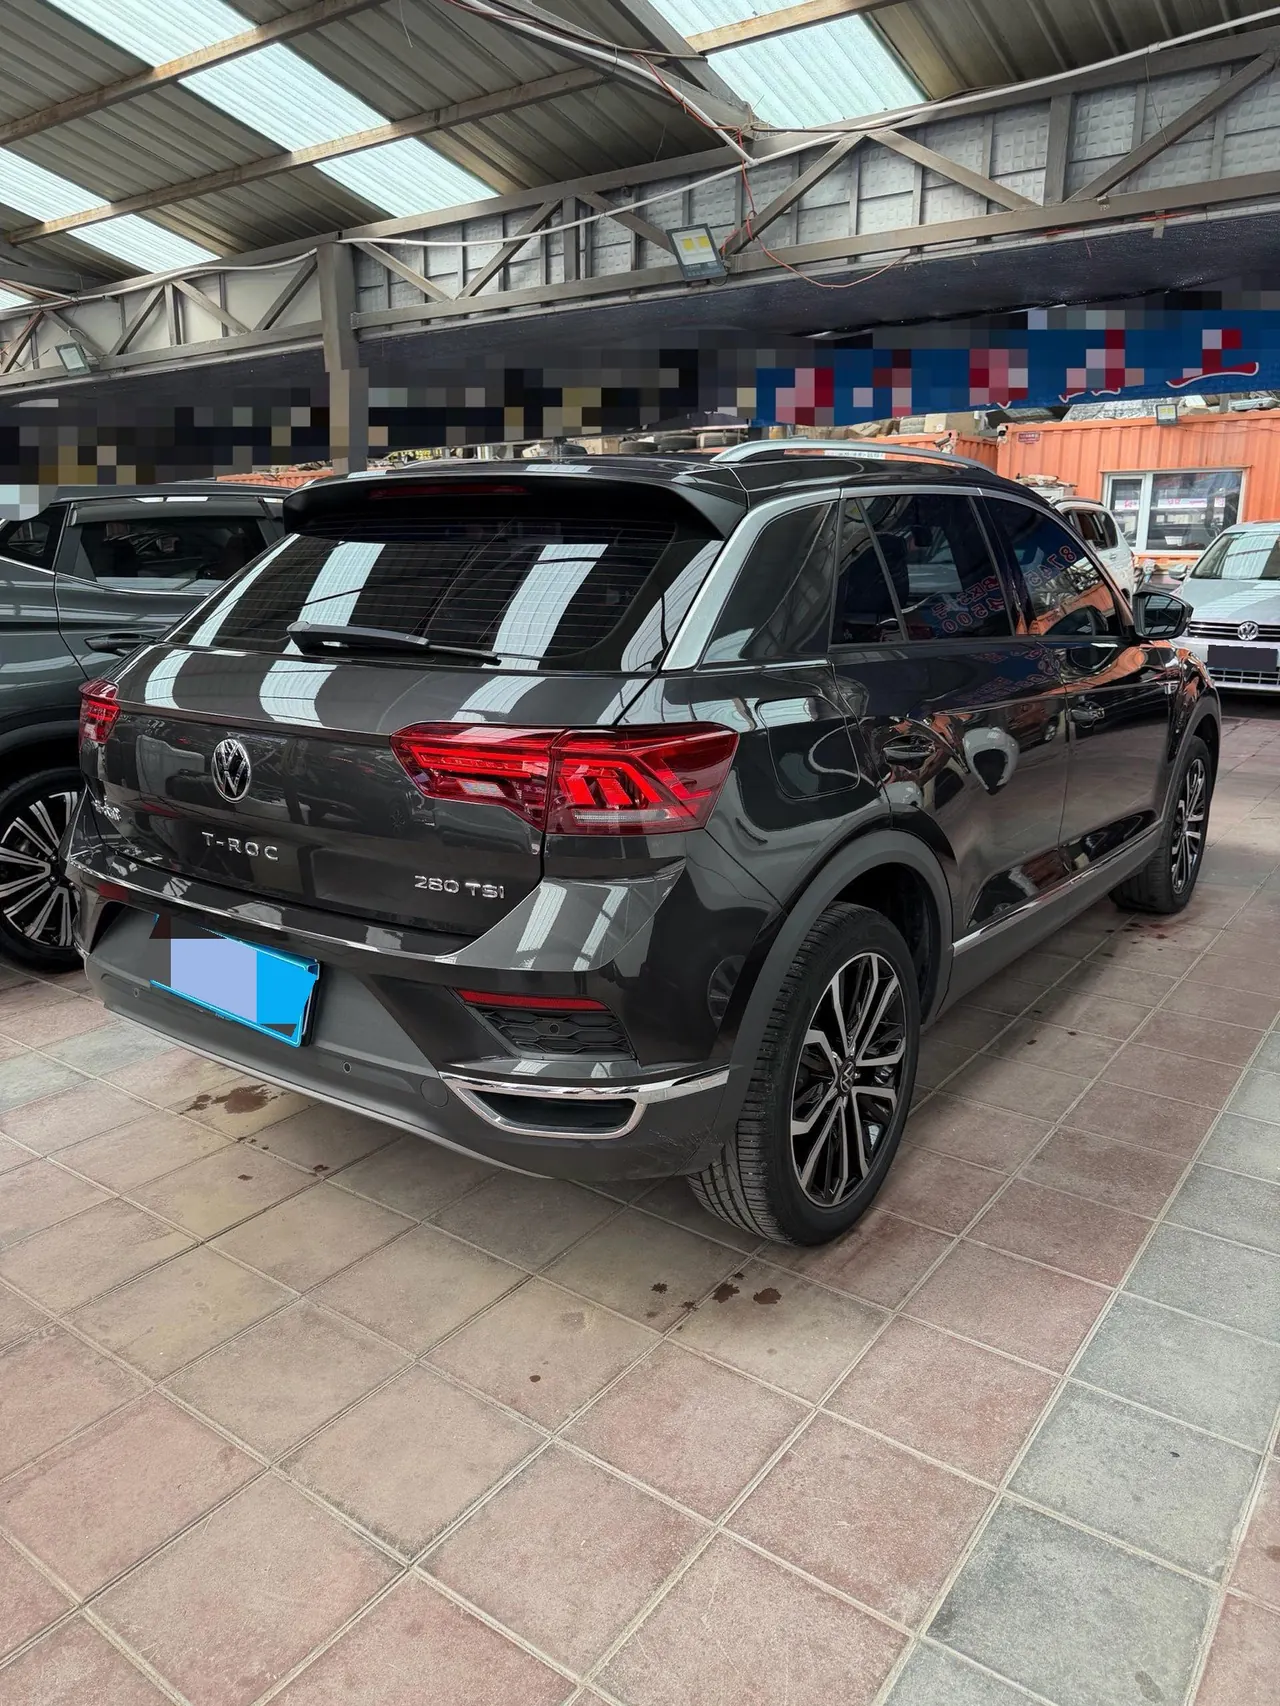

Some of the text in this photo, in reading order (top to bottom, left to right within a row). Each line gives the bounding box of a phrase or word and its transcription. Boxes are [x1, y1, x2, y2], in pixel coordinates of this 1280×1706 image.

[201, 831, 279, 860] T-ROC
[414, 875, 505, 899] 280 TSI
